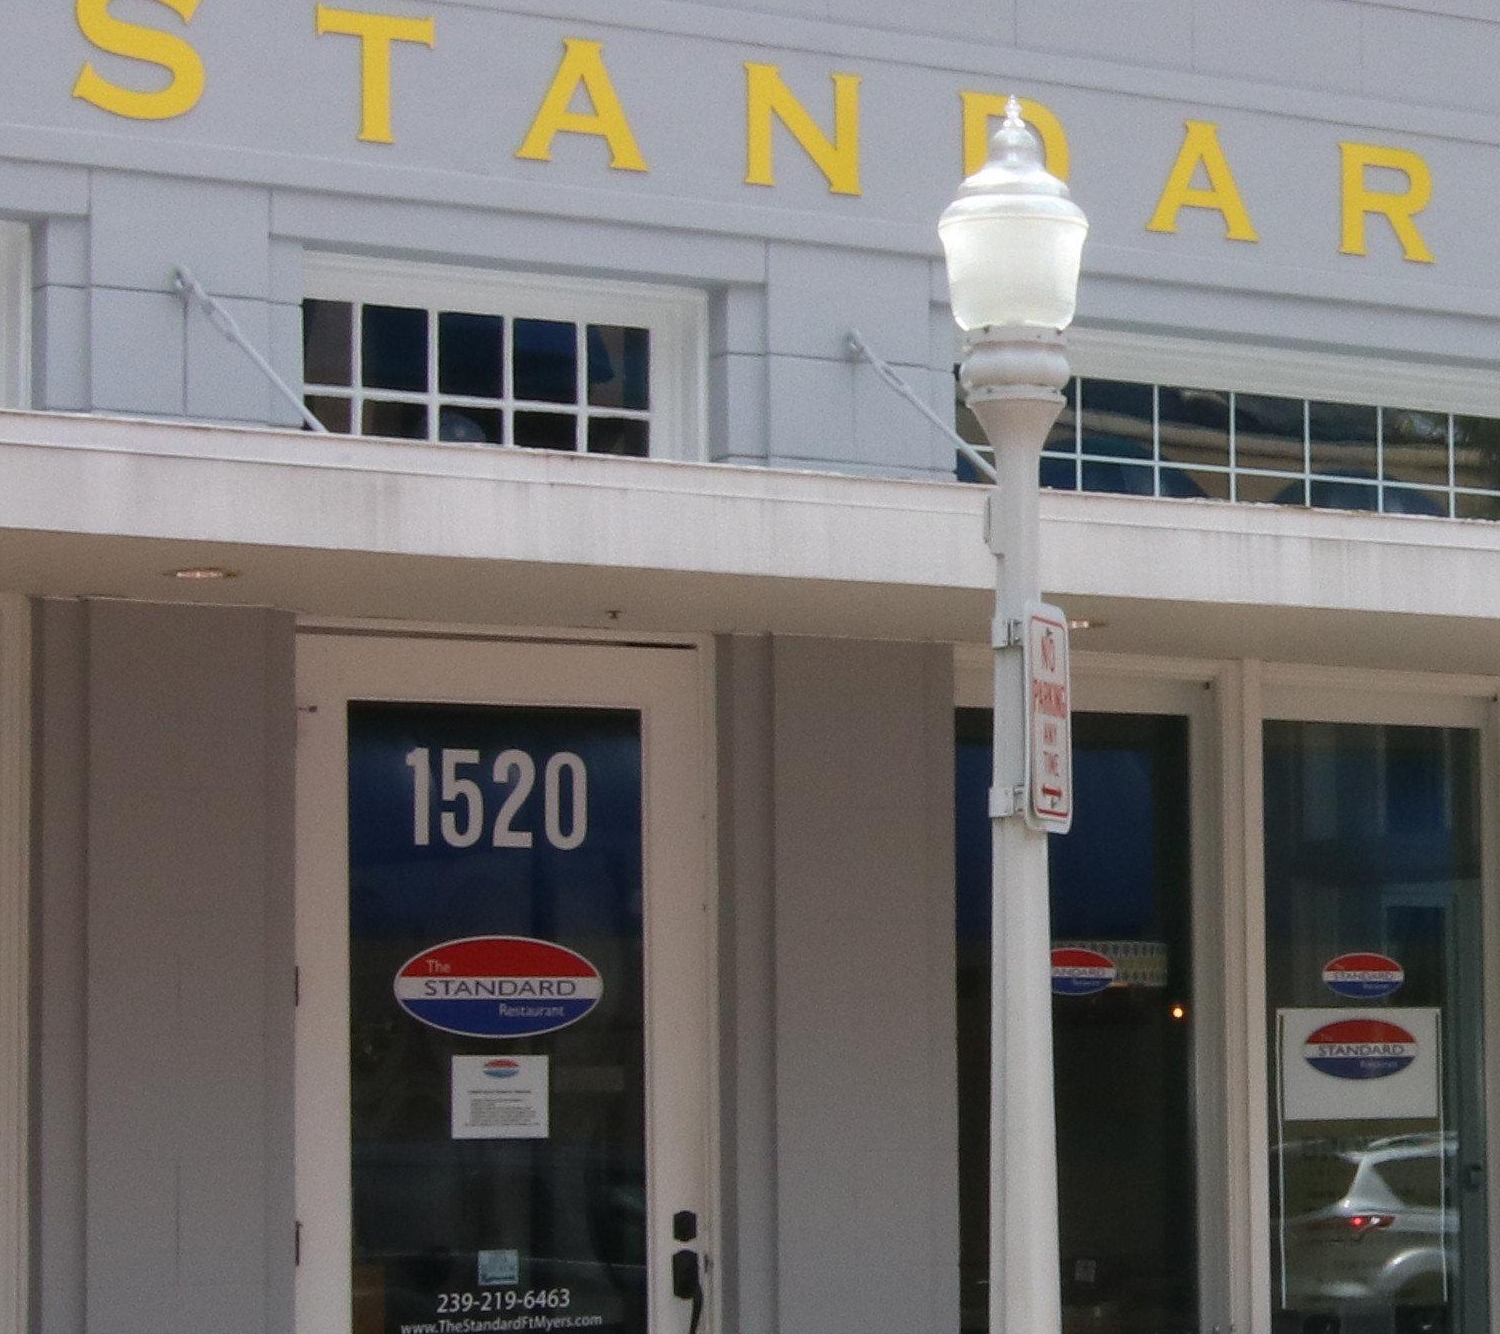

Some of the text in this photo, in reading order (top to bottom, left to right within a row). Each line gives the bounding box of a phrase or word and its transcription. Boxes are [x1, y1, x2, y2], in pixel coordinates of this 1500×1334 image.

[405, 746, 589, 851] 1520
[425, 959, 451, 974] The
[424, 979, 577, 997] STANDARD
[499, 1003, 566, 1018] Restaurant
[1318, 1044, 1404, 1056] STANDARD
[436, 1288, 571, 1314] 239-219-6463
